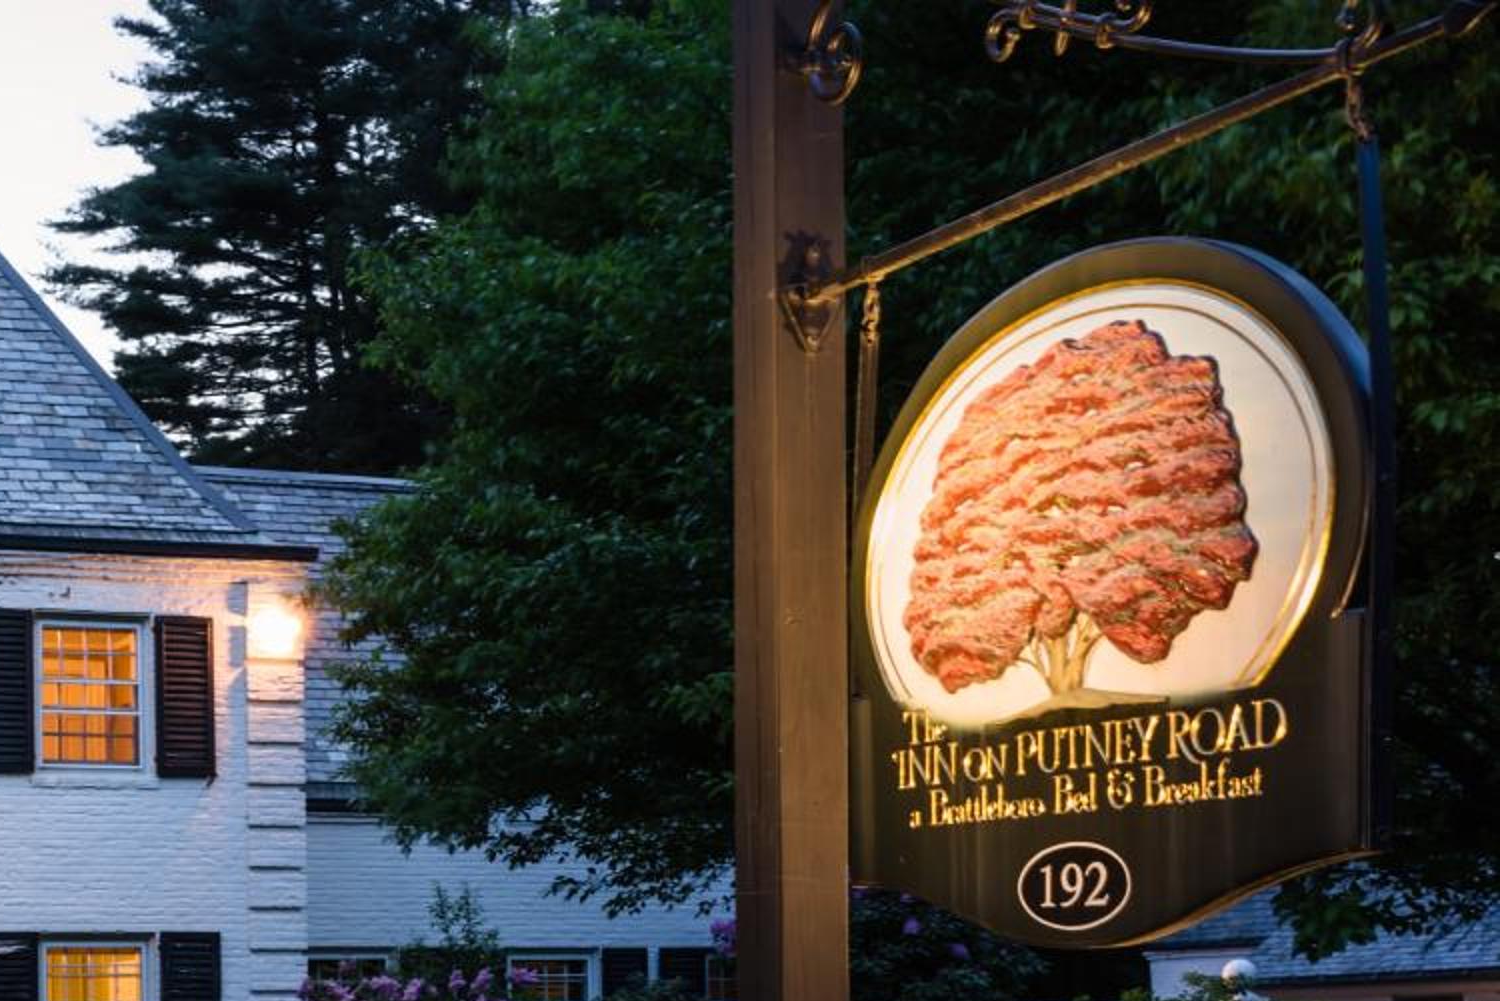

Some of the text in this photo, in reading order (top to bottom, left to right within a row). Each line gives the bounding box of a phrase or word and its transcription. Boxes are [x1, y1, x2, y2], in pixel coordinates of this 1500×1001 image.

[891, 741, 957, 789] INN
[1015, 715, 1159, 777] PUTNEY
[1167, 698, 1288, 764] ROAD
[909, 758, 1263, 828] a Brattleboro Bed & Breakfast
[1039, 861, 1109, 909] 192
